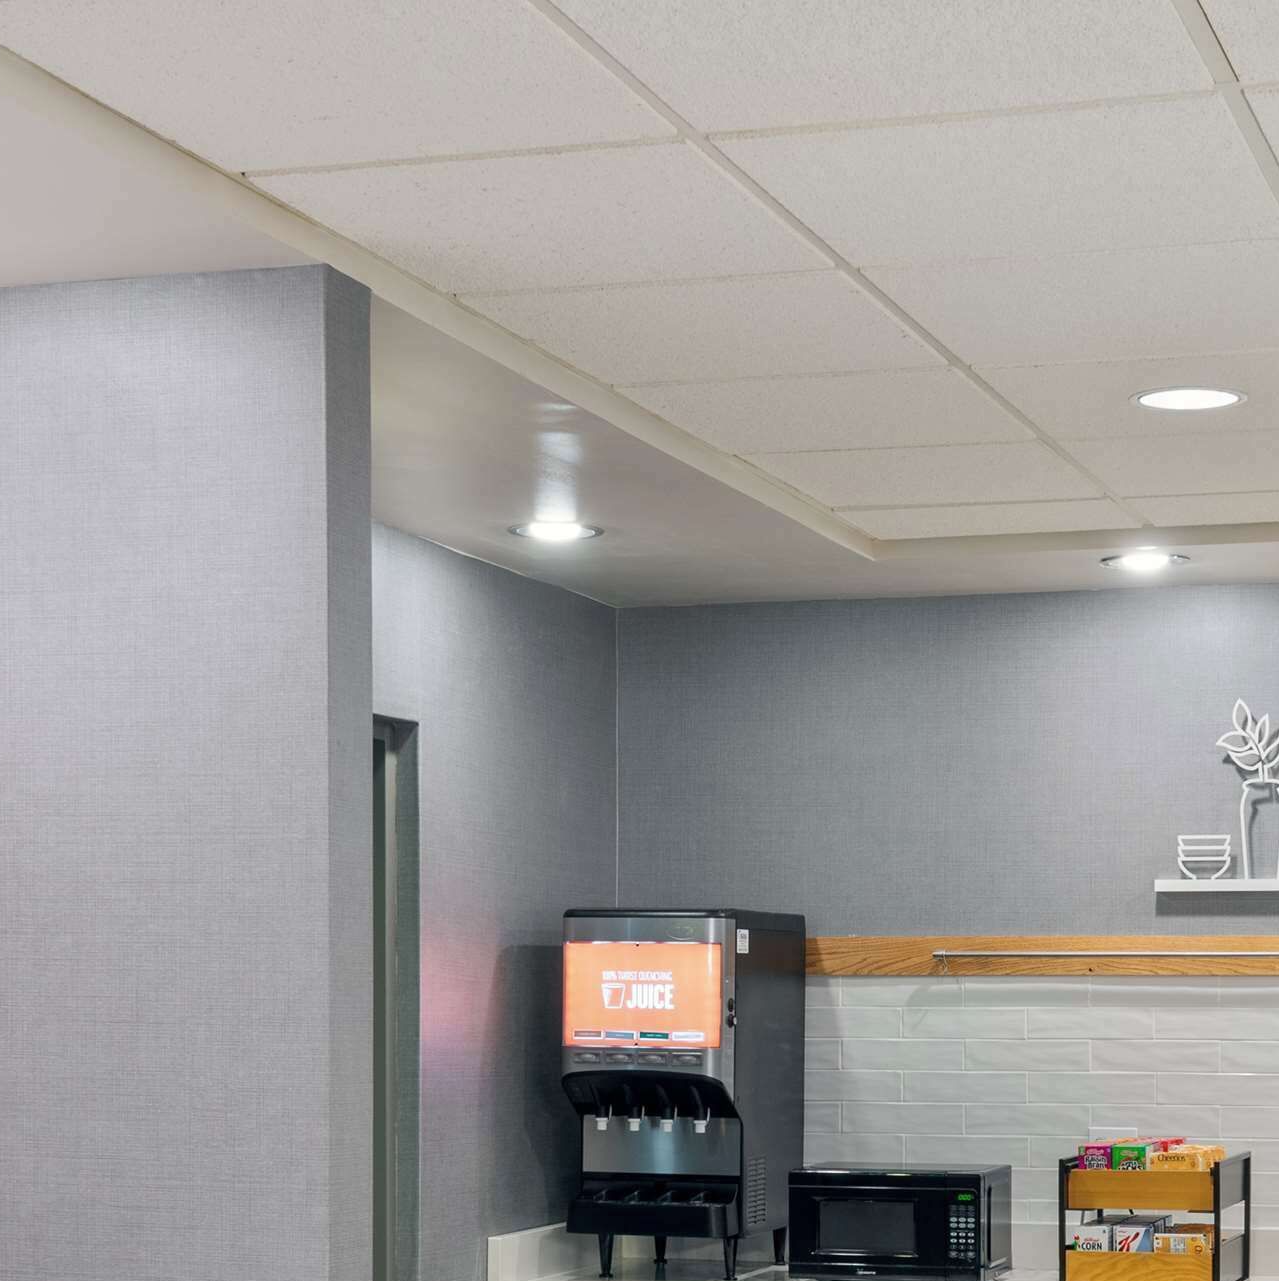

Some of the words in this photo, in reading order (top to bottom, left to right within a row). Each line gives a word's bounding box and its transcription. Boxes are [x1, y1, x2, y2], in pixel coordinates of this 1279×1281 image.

[626, 983, 675, 1010] JUICE
[1157, 1153, 1186, 1162] Cheerios
[1080, 1242, 1103, 1251] CORN
